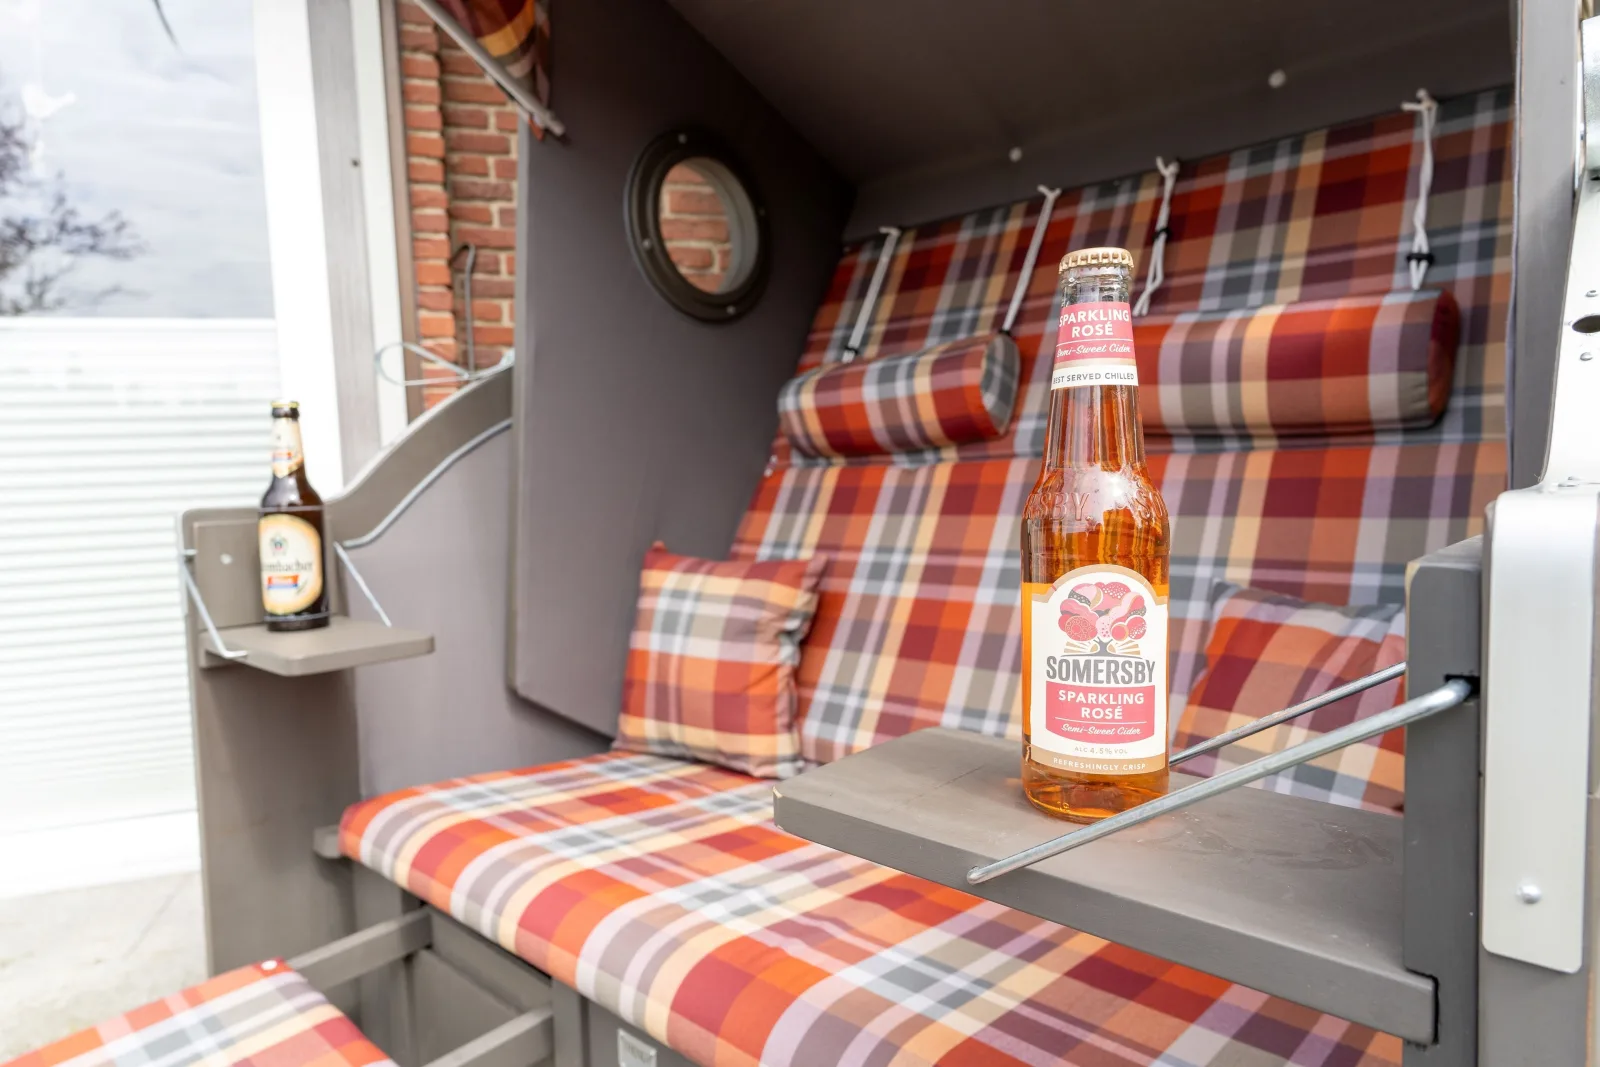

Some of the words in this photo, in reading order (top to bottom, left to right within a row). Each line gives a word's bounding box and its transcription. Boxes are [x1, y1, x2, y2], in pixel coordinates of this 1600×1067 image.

[1059, 308, 1129, 327] SPARKLING
[1071, 321, 1114, 338] ROSÉ
[1056, 344, 1107, 358] Semi-Sweet
[1109, 343, 1131, 353] Cider
[1066, 372, 1102, 382] SERVED
[1104, 372, 1135, 380] CHILLED
[1045, 655, 1156, 685] SOMERSBY
[1058, 689, 1145, 705] SPARKLING
[1081, 706, 1123, 719] ROSÉ
[1061, 723, 1115, 735] Semi-Sweet
[1117, 726, 1142, 735] Cider
[1089, 747, 1113, 755] 4.5%
[1053, 757, 1119, 771] REFRESHINGLY
[1122, 763, 1146, 771] CRISP
